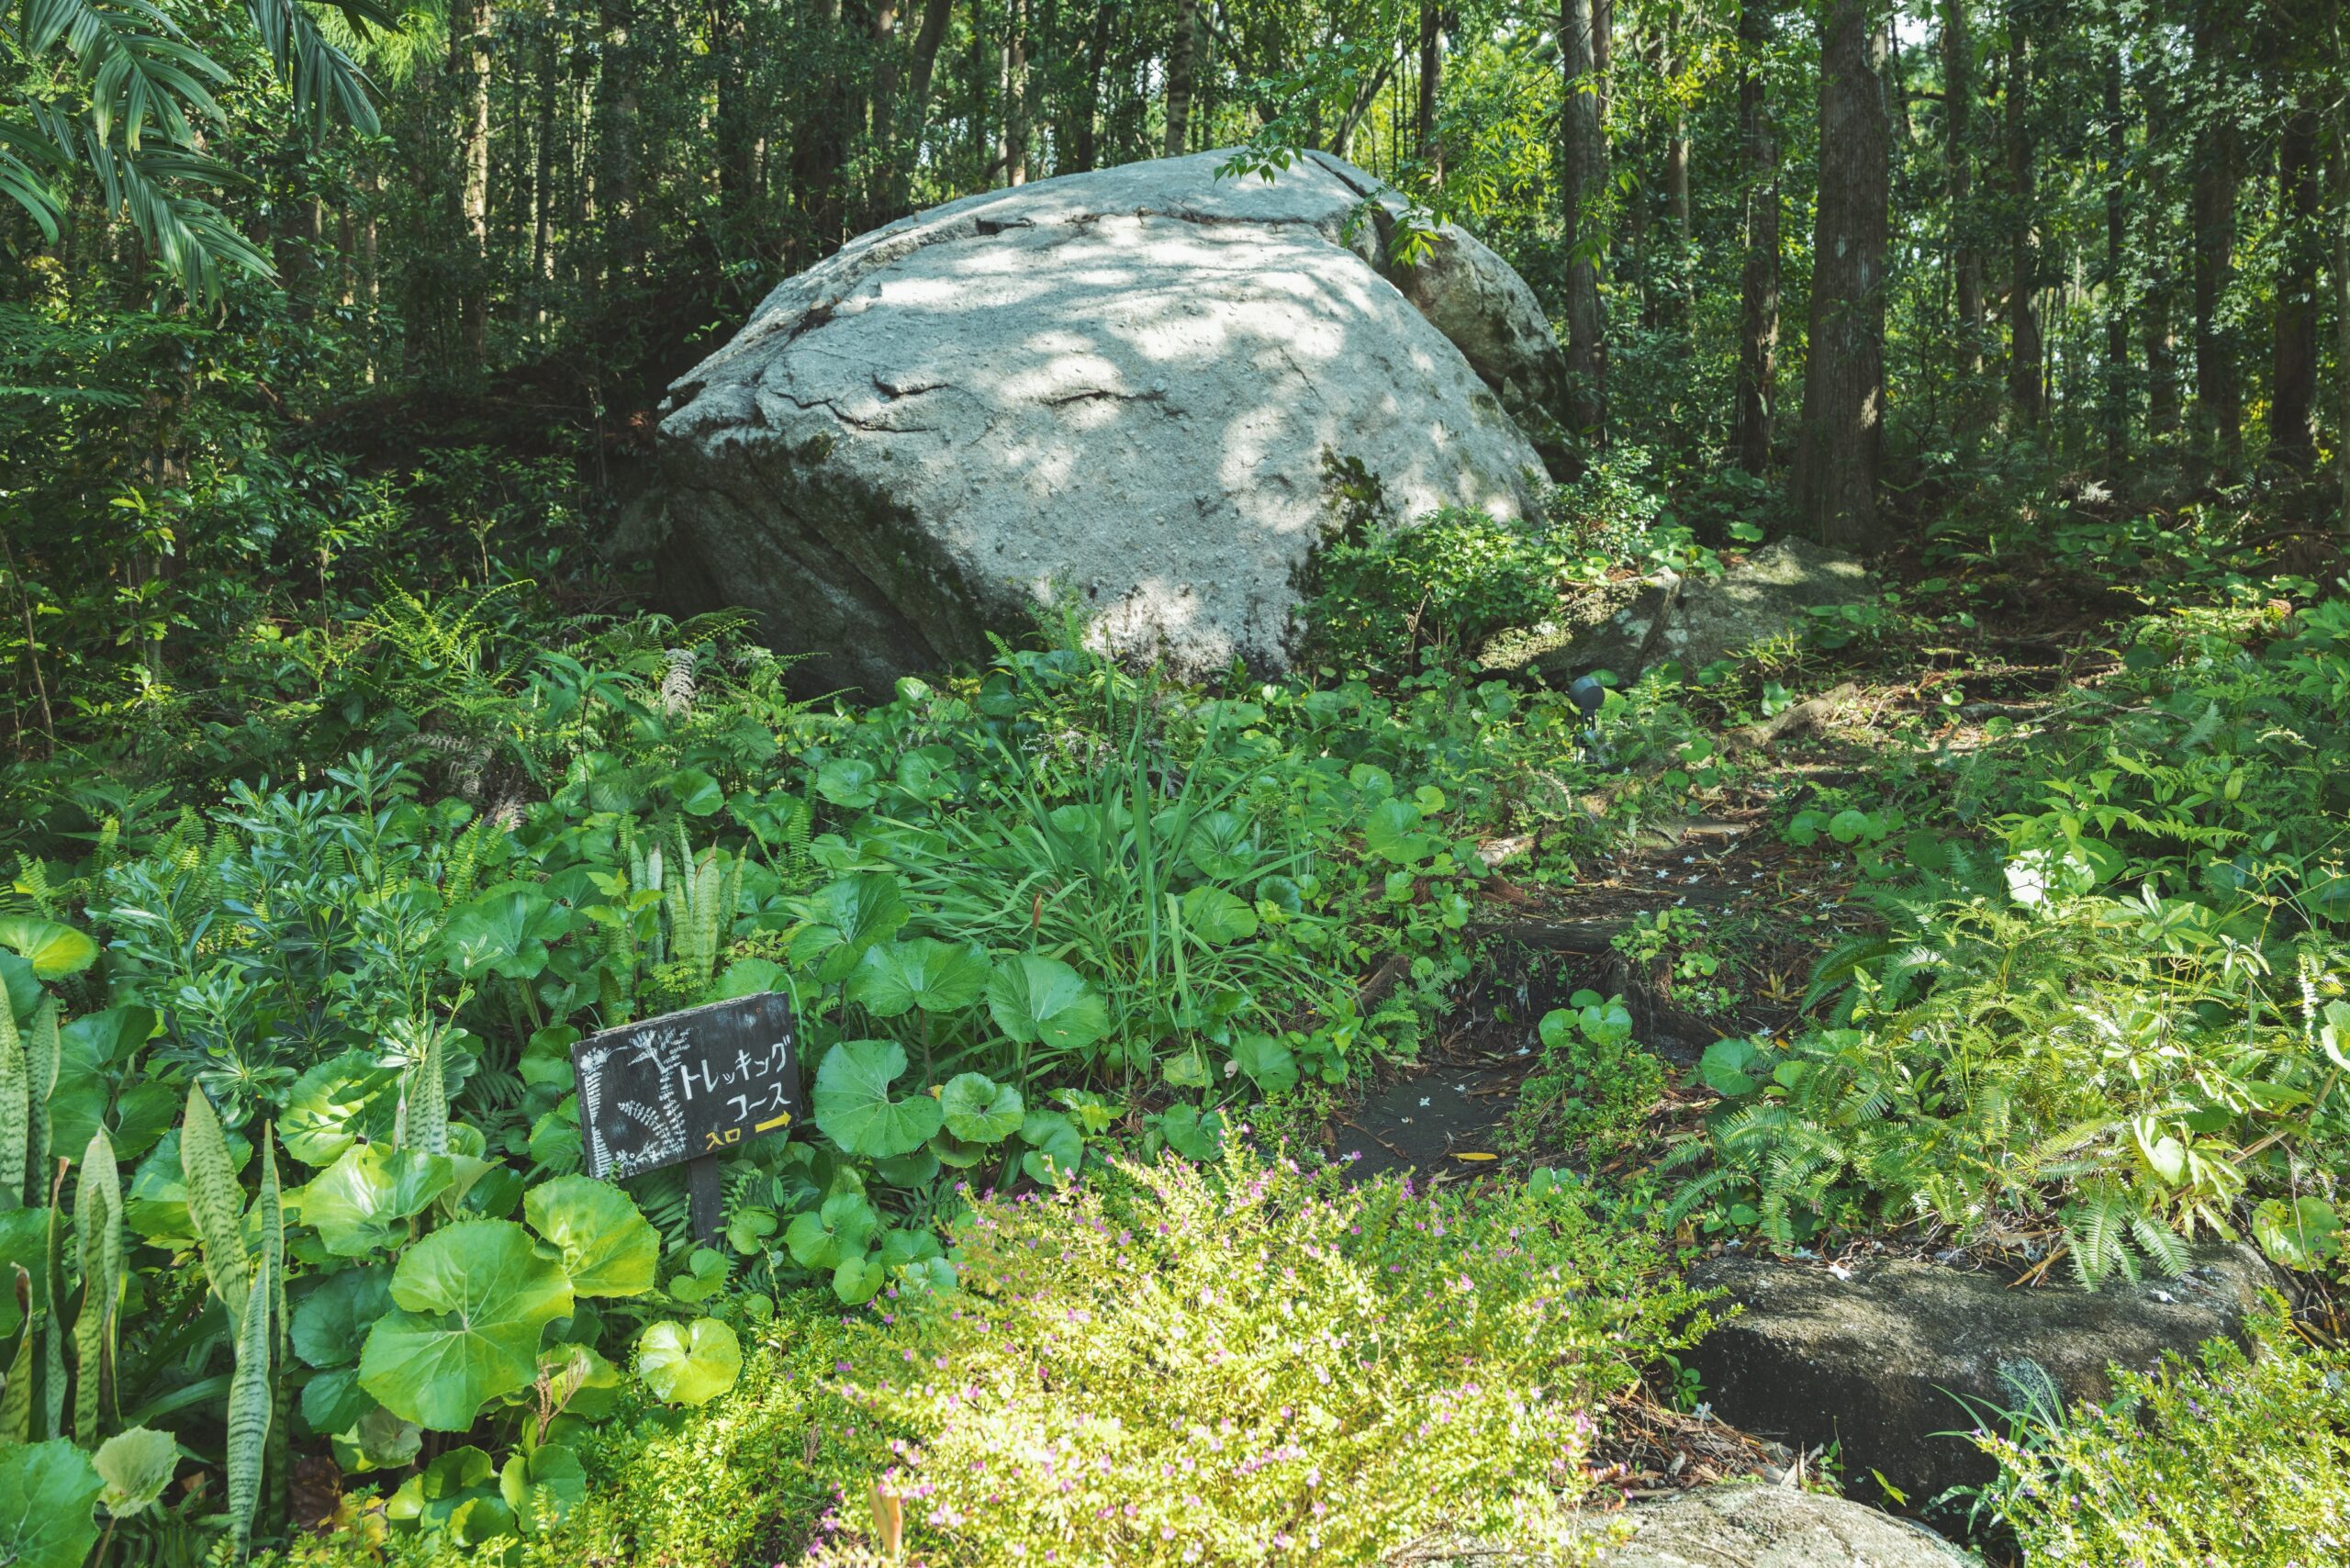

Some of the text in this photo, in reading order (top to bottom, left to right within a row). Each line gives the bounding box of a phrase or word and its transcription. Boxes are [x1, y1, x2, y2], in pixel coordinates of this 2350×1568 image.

[680, 1035, 791, 1101] トレッキング
[726, 1081, 791, 1123] コース
[705, 1127, 741, 1151] 入口
